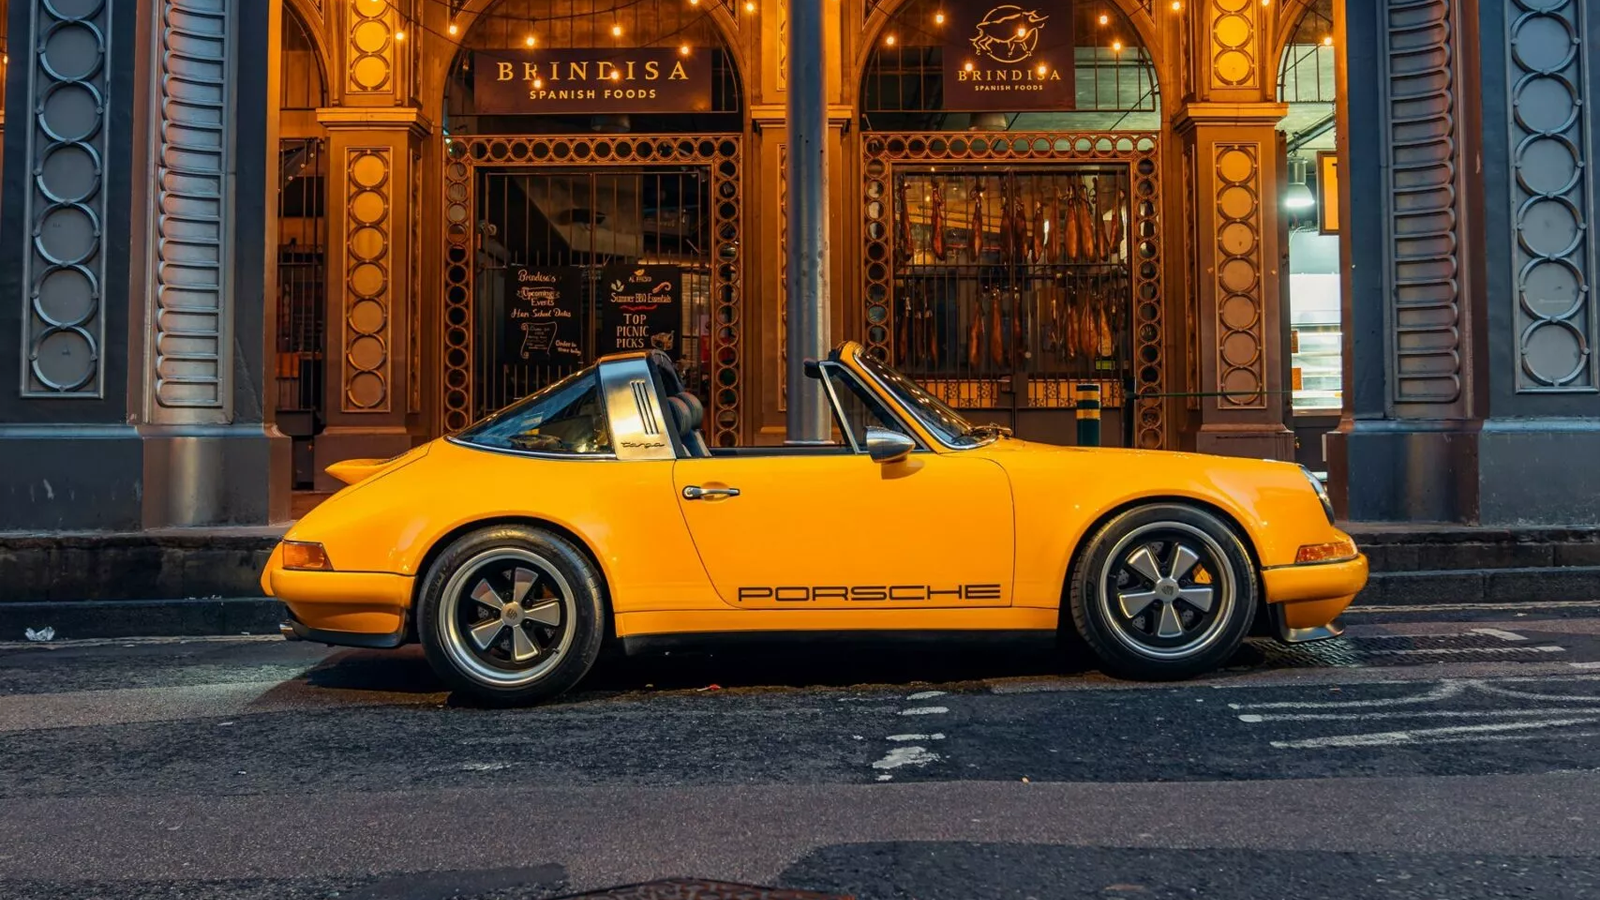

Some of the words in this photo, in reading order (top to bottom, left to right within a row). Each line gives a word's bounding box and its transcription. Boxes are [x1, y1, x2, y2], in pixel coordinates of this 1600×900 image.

[496, 60, 689, 81] BRINDISA
[529, 90, 595, 100] SPANISH
[604, 89, 657, 99] FOODS
[610, 292, 635, 303] Summer
[622, 313, 647, 325] TOP
[616, 326, 650, 338] PICNIC
[616, 338, 645, 349] PICKS
[738, 583, 1001, 602] PORSCHE
